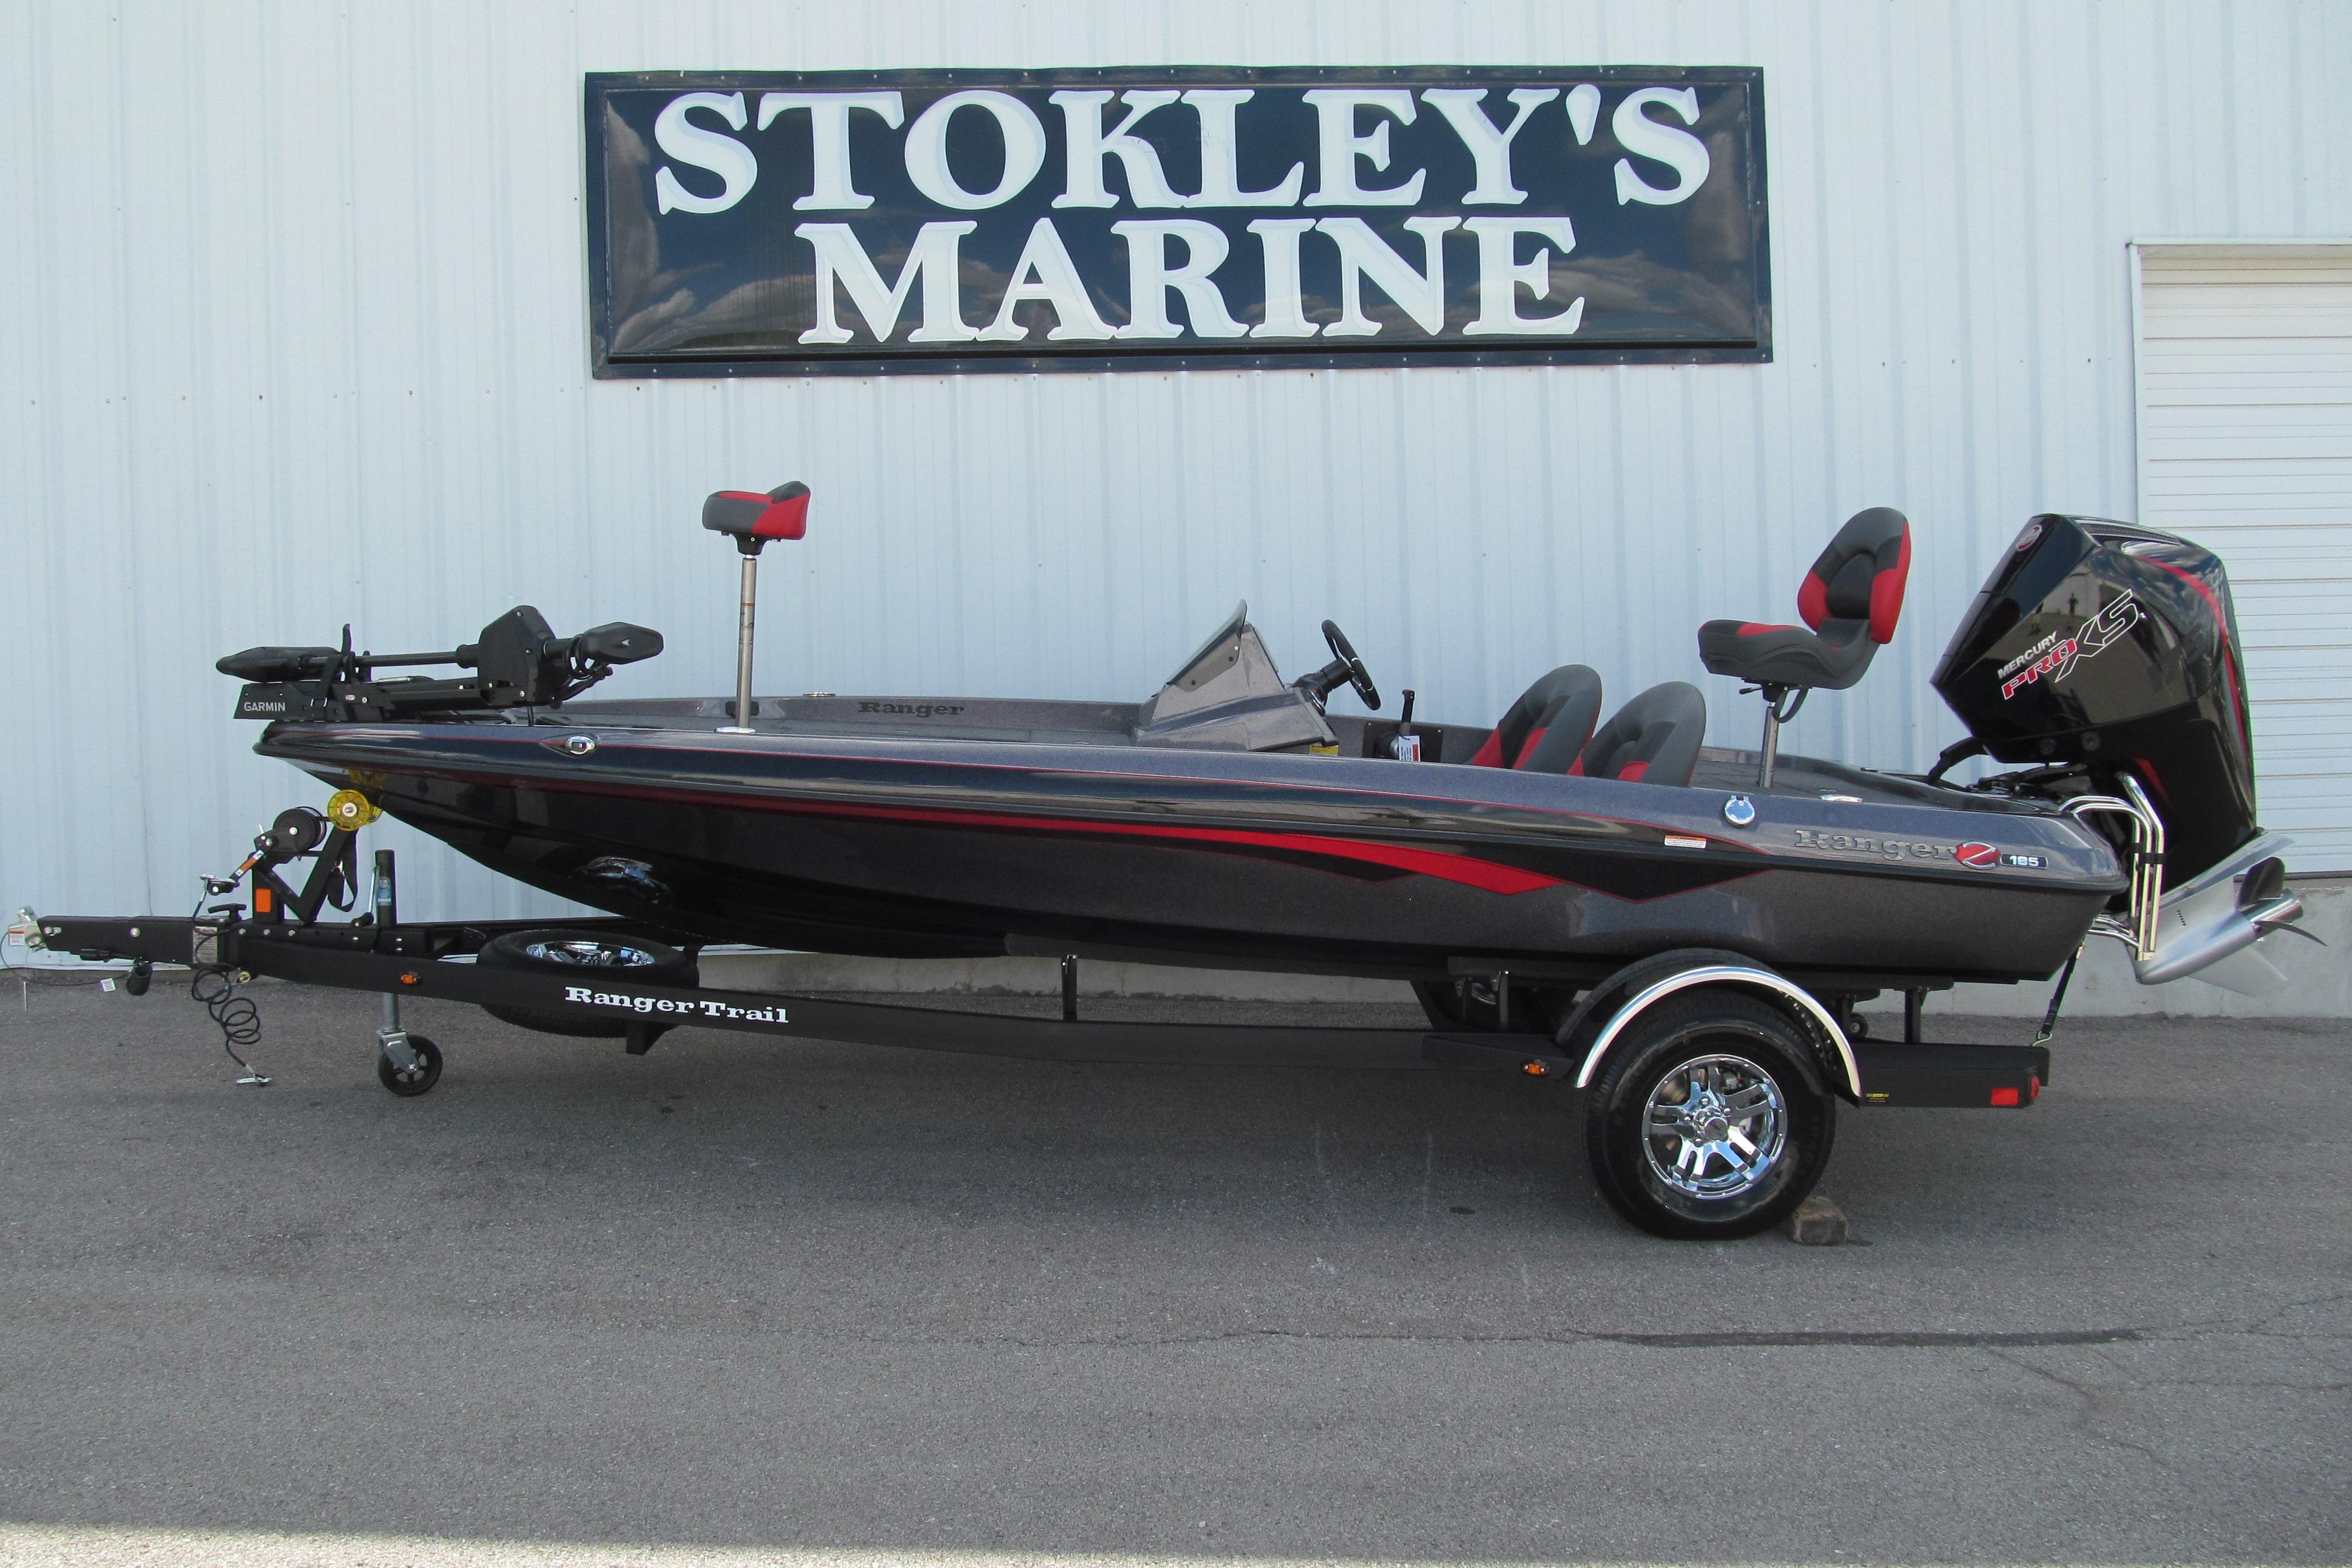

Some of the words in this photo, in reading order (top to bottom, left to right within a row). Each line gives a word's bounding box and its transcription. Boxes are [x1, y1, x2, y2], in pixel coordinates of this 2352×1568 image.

[654, 84, 1711, 216] STOKLEY'S
[793, 216, 1585, 345] MARINE
[1997, 630, 2057, 679] MERCURY
[243, 701, 286, 712] GARMIN
[857, 701, 965, 718] Ranger
[1795, 830, 1957, 861] Ranger
[565, 986, 696, 1014] Ranger
[699, 1000, 789, 1024] Trail
